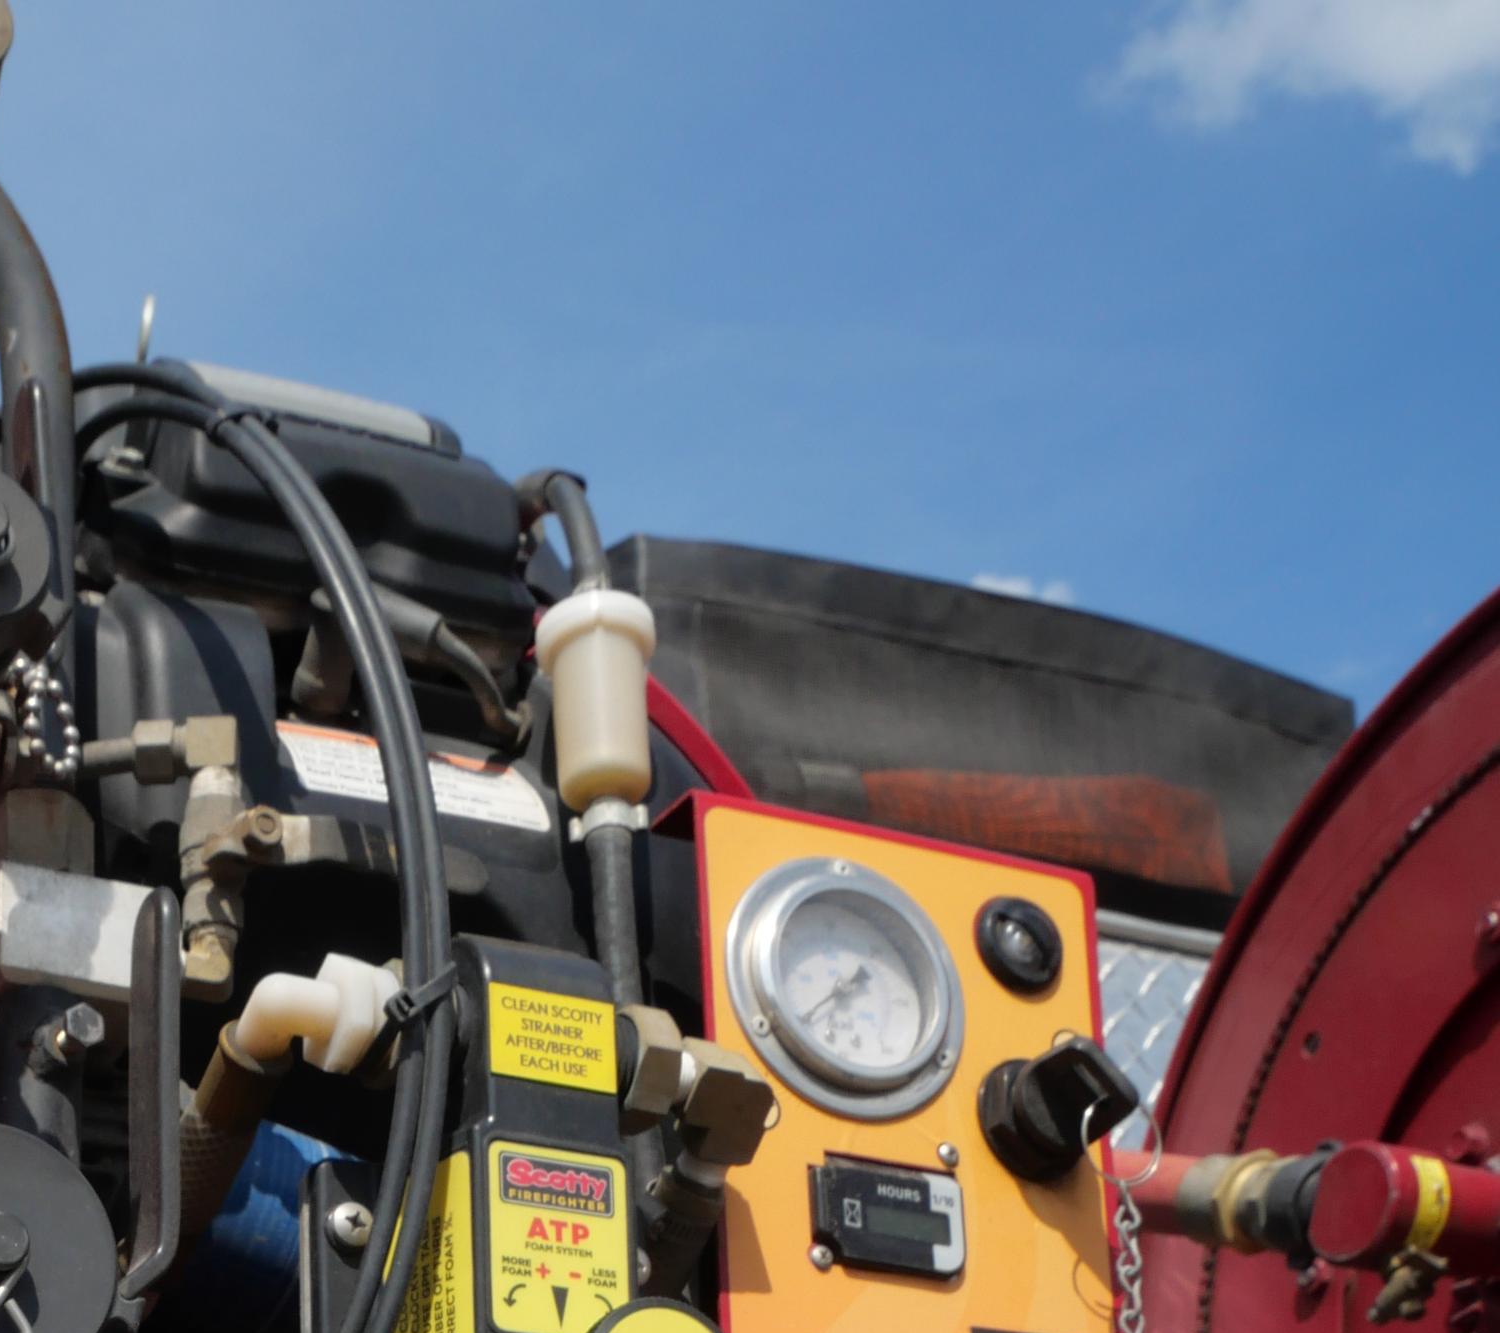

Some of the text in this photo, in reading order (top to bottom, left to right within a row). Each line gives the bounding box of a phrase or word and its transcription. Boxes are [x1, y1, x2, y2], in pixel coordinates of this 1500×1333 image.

[501, 995, 603, 1026] CLEAN SCOTTY
[520, 1017, 584, 1041] STRAINER
[505, 1033, 603, 1063] AFTER/BEFORE
[519, 1053, 588, 1078] EACH USE
[506, 1156, 608, 1201] Scotty
[507, 1187, 606, 1213] FIREFIGHTER
[876, 1182, 922, 1203] HOURS
[526, 1216, 590, 1246] ATP
[444, 1234, 455, 1282] FOAM
[501, 1254, 532, 1267] MORE
[524, 1240, 593, 1259] FOAM SYSTEM
[501, 1265, 532, 1278] FOAM
[592, 1267, 617, 1279] LESS
[433, 1276, 443, 1296] OF
[587, 1278, 617, 1290] FOAM
